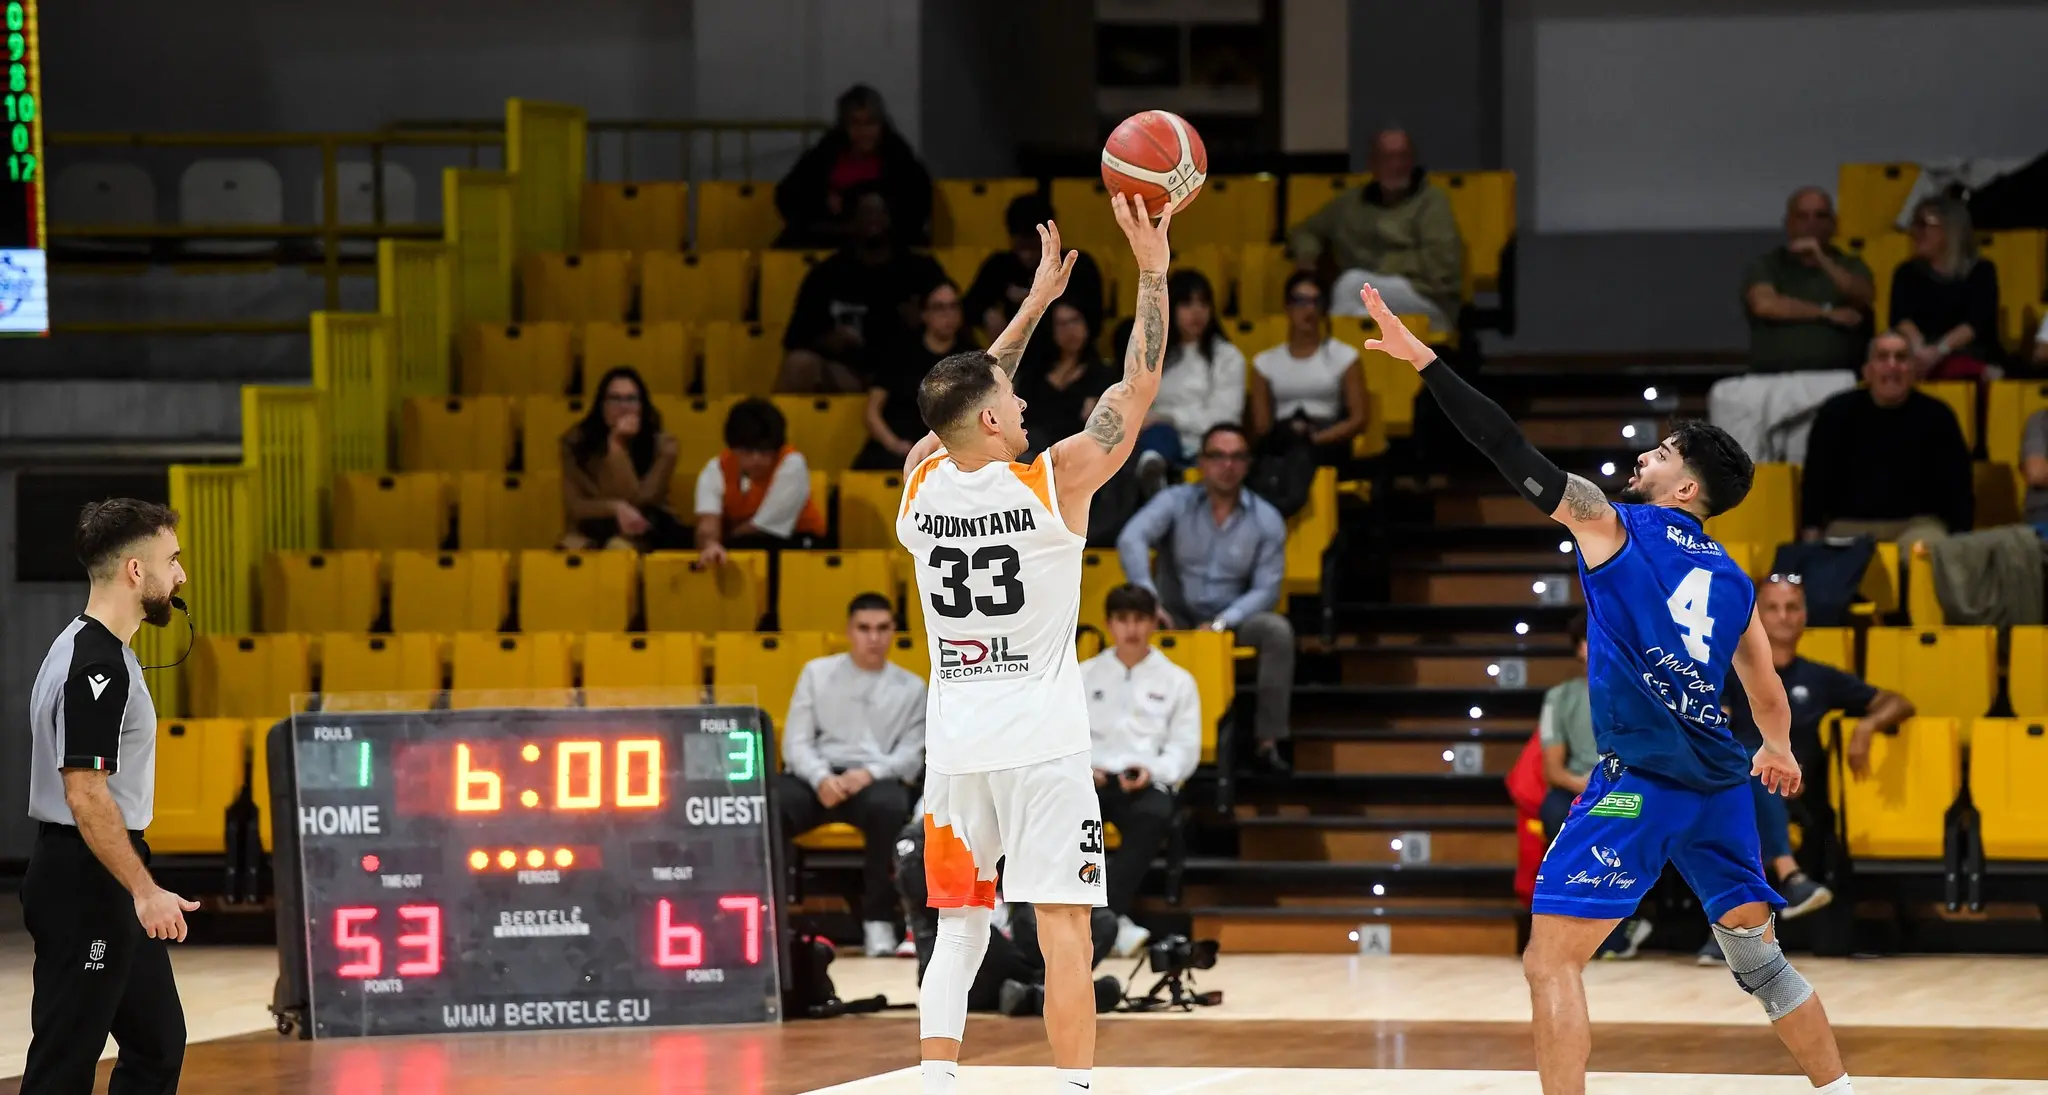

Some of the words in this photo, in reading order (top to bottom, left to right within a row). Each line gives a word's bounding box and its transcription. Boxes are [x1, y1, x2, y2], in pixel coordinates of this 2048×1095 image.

[7, 1, 24, 31] 0
[8, 33, 25, 61] 9
[9, 63, 26, 92] 8
[5, 94, 35, 122] 10
[12, 123, 29, 152] 0
[7, 154, 37, 182] 12
[928, 544, 1025, 619] 33
[1666, 567, 1714, 665] 4
[938, 636, 1029, 668] EDIL
[940, 662, 1029, 680] DECORATION
[314, 726, 353, 741] FOULS
[700, 718, 738, 733] FOULS
[359, 741, 371, 788] 1
[728, 731, 754, 781] 3
[456, 740, 661, 811] 6:00
[300, 804, 381, 836] HOME
[685, 795, 766, 826] GUEST
[1080, 819, 1103, 854] 33
[1565, 870, 1602, 888] Liberty
[1603, 871, 1637, 889] Viaggi
[334, 906, 441, 977] 53
[656, 896, 760, 966] 67
[84, 962, 105, 971] FIP
[685, 967, 725, 982] POINTS
[364, 978, 404, 993] POINTS
[504, 998, 651, 1026] BERTELE.EU
